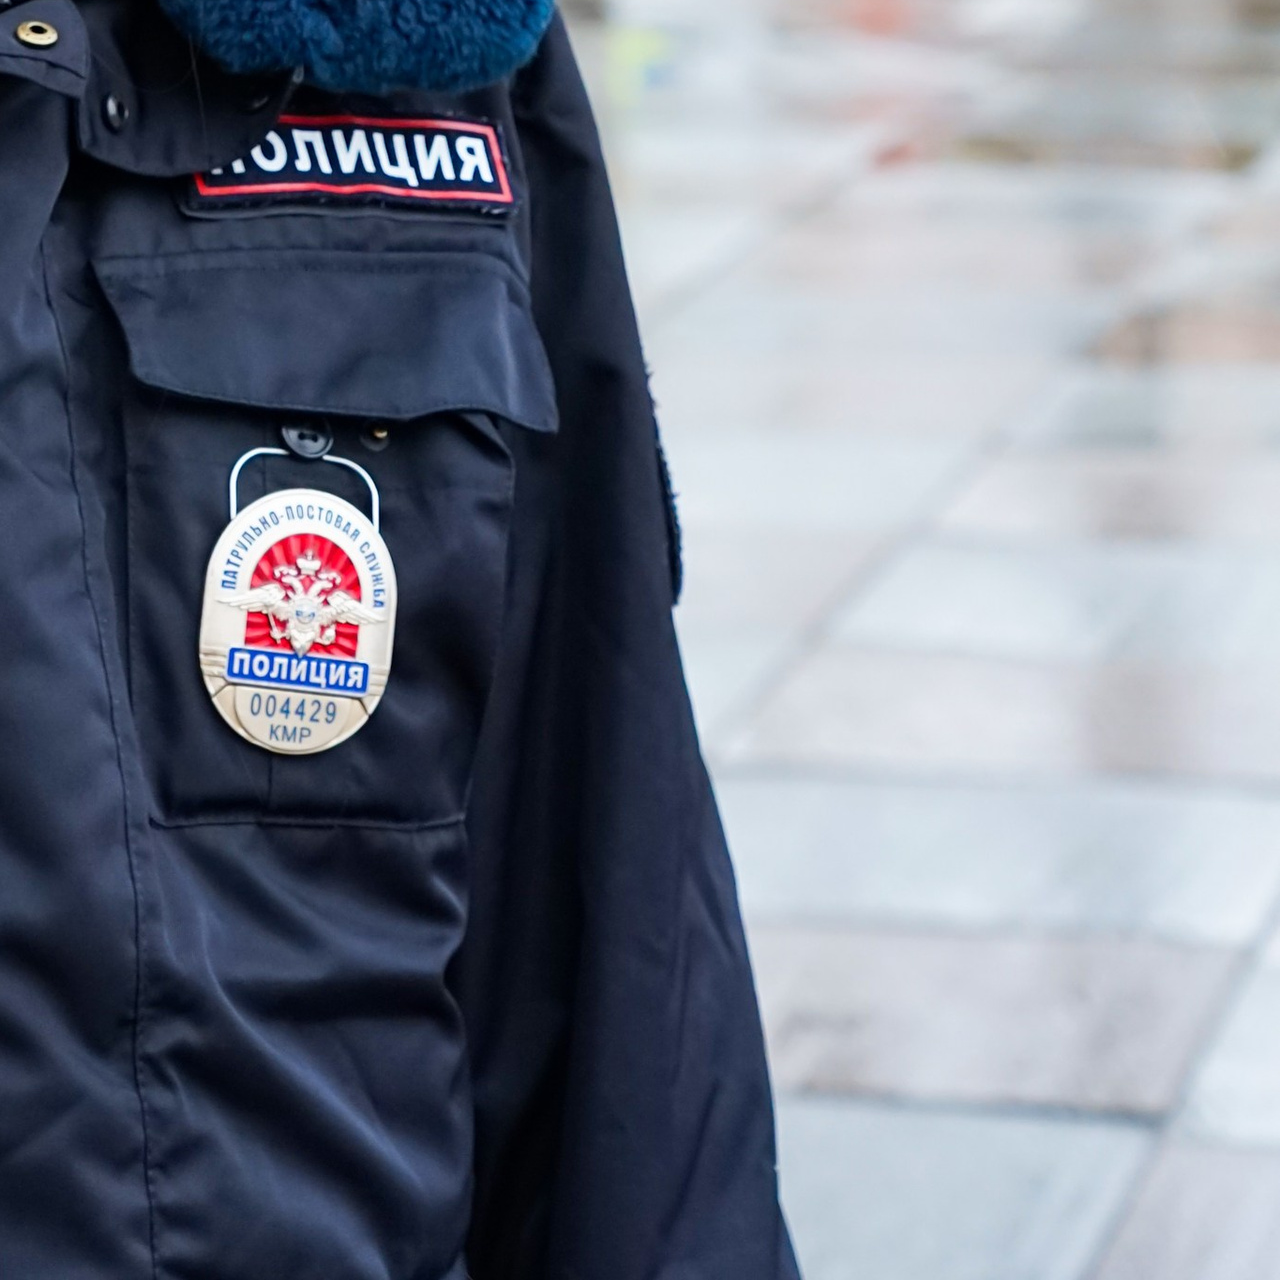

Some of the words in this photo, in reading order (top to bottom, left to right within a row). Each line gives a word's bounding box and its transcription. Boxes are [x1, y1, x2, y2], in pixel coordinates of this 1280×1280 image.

[211, 129, 494, 187] ОЛИЦИЯ
[221, 504, 361, 590] ПАТРУЛЬНО-ПОСТОВАЯ
[359, 541, 386, 609] СЛУЖБА
[232, 651, 364, 688] ПОЛИЦИЯ
[250, 693, 337, 724] 004429
[270, 724, 312, 744] КМР
